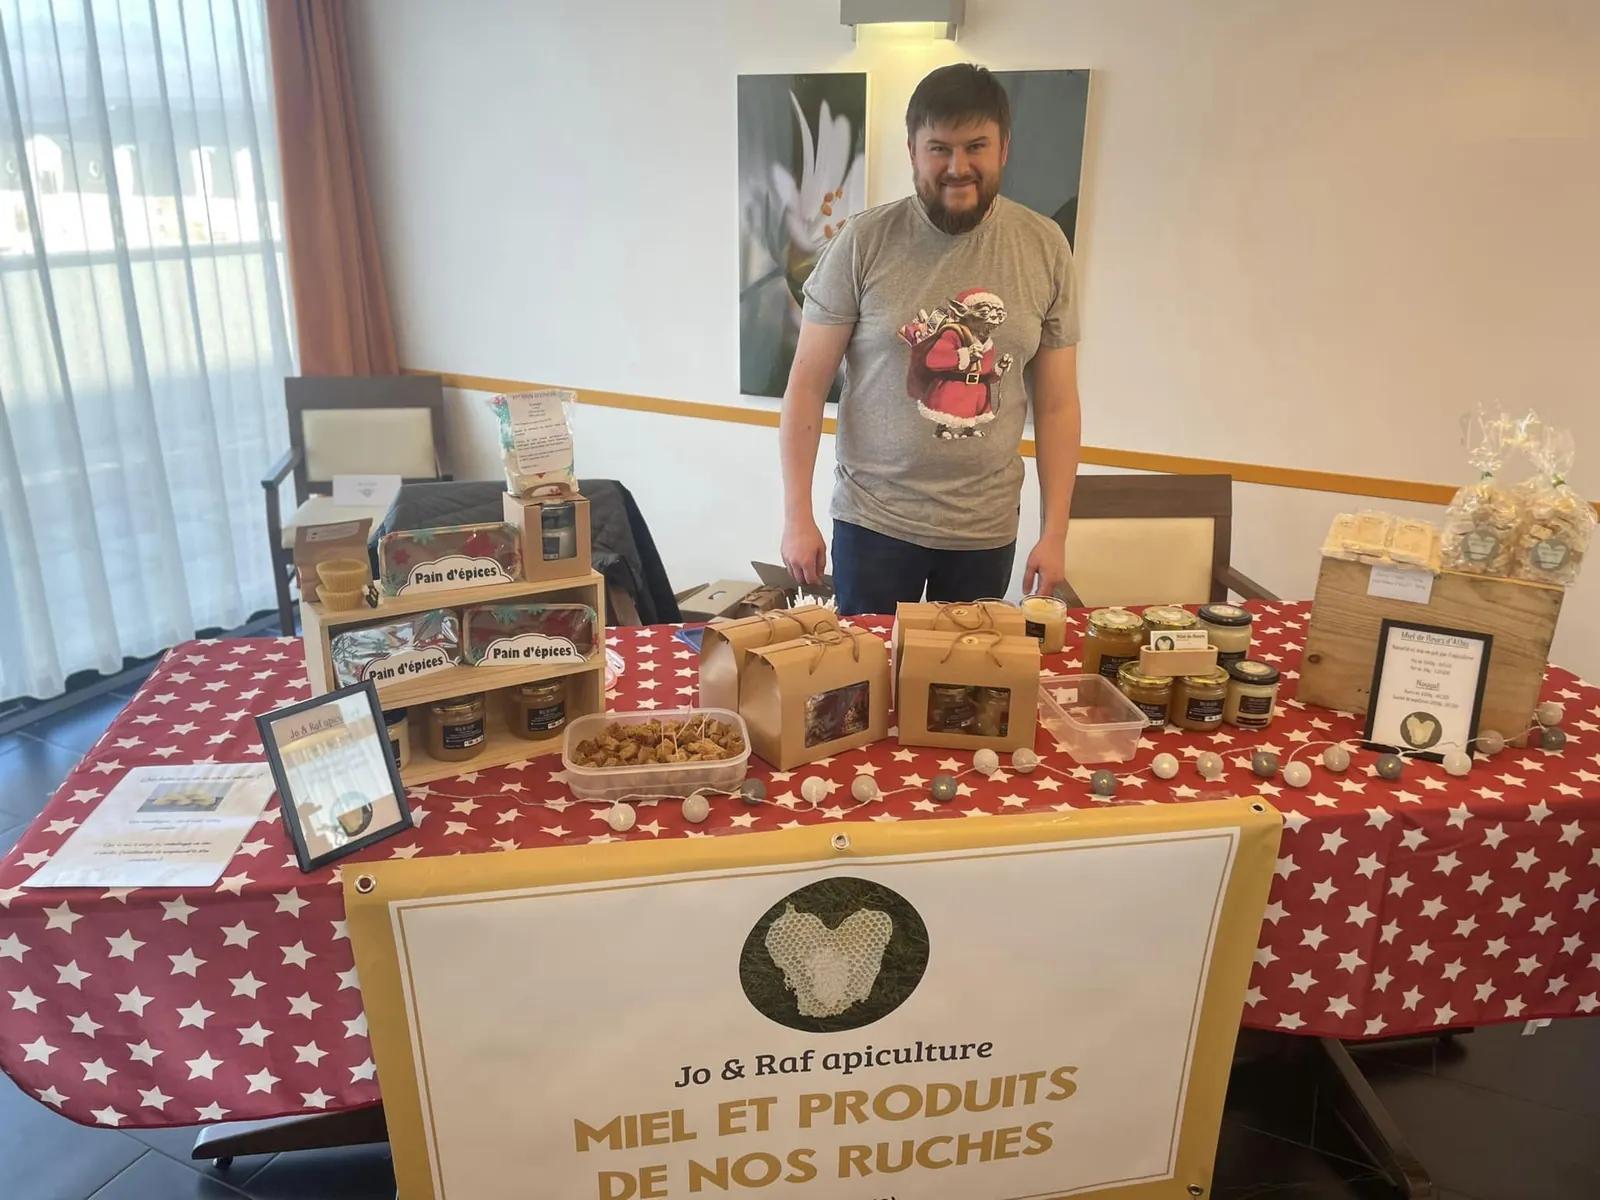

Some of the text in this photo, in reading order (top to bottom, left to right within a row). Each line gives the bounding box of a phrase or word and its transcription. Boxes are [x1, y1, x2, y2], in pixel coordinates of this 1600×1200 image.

[415, 566, 497, 585] Pain d'épices
[1401, 631, 1415, 640] Miel
[493, 646, 571, 659] Pain d'épices
[369, 657, 444, 680] Pain d'épices
[290, 729, 299, 739] Jo
[301, 725, 308, 735] &
[310, 720, 322, 731] Raf
[674, 1040, 994, 1088] Jo & Raf apiculture
[574, 1065, 1078, 1152] MIEL ET PRODUITS
[598, 1121, 1054, 1200] DE NOS RUCHES
